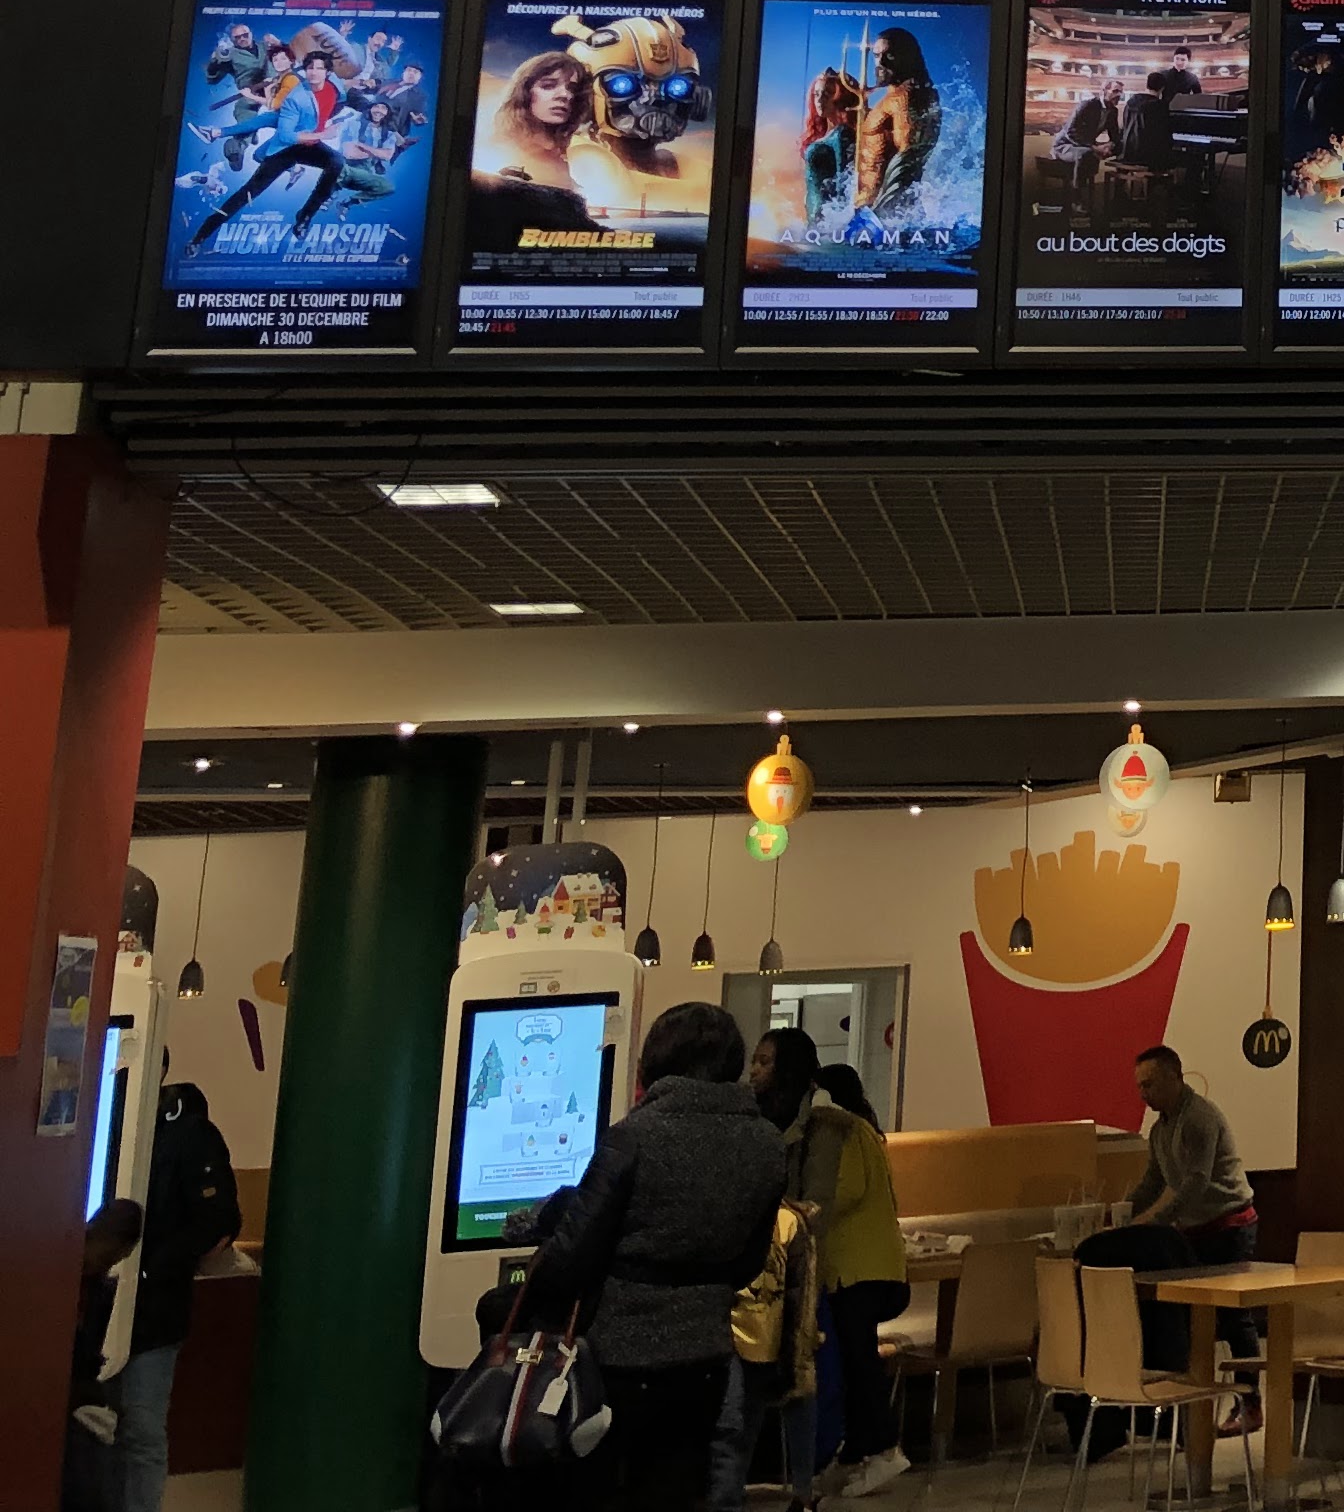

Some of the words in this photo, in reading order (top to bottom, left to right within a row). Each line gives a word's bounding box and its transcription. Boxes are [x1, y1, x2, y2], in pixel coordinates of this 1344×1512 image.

[507, 1, 569, 15] DÉCOUVREZ
[570, 6, 584, 15] LA
[584, 6, 643, 17] NAISSANCE
[644, 7, 669, 18] D'UN
[670, 4, 705, 19] HÉROS
[213, 222, 292, 255] NICKY
[286, 223, 391, 255] LARSON
[779, 229, 950, 246] AQUAMAN
[1036, 235, 1066, 253] au
[1068, 231, 1120, 253] bout
[1121, 231, 1160, 253] des
[1162, 232, 1227, 259] doigts
[177, 293, 195, 308] EN
[198, 293, 267, 307] PRESENCE
[270, 293, 287, 307] DE
[290, 293, 348, 307] L'EQUIPE
[350, 293, 369, 307] DU
[372, 293, 402, 307] FILM
[206, 312, 275, 327] DIMANCHE
[278, 312, 295, 327] 30
[298, 312, 369, 326] DECEMBRE
[259, 332, 269, 345] A
[273, 331, 313, 345] 18h00
